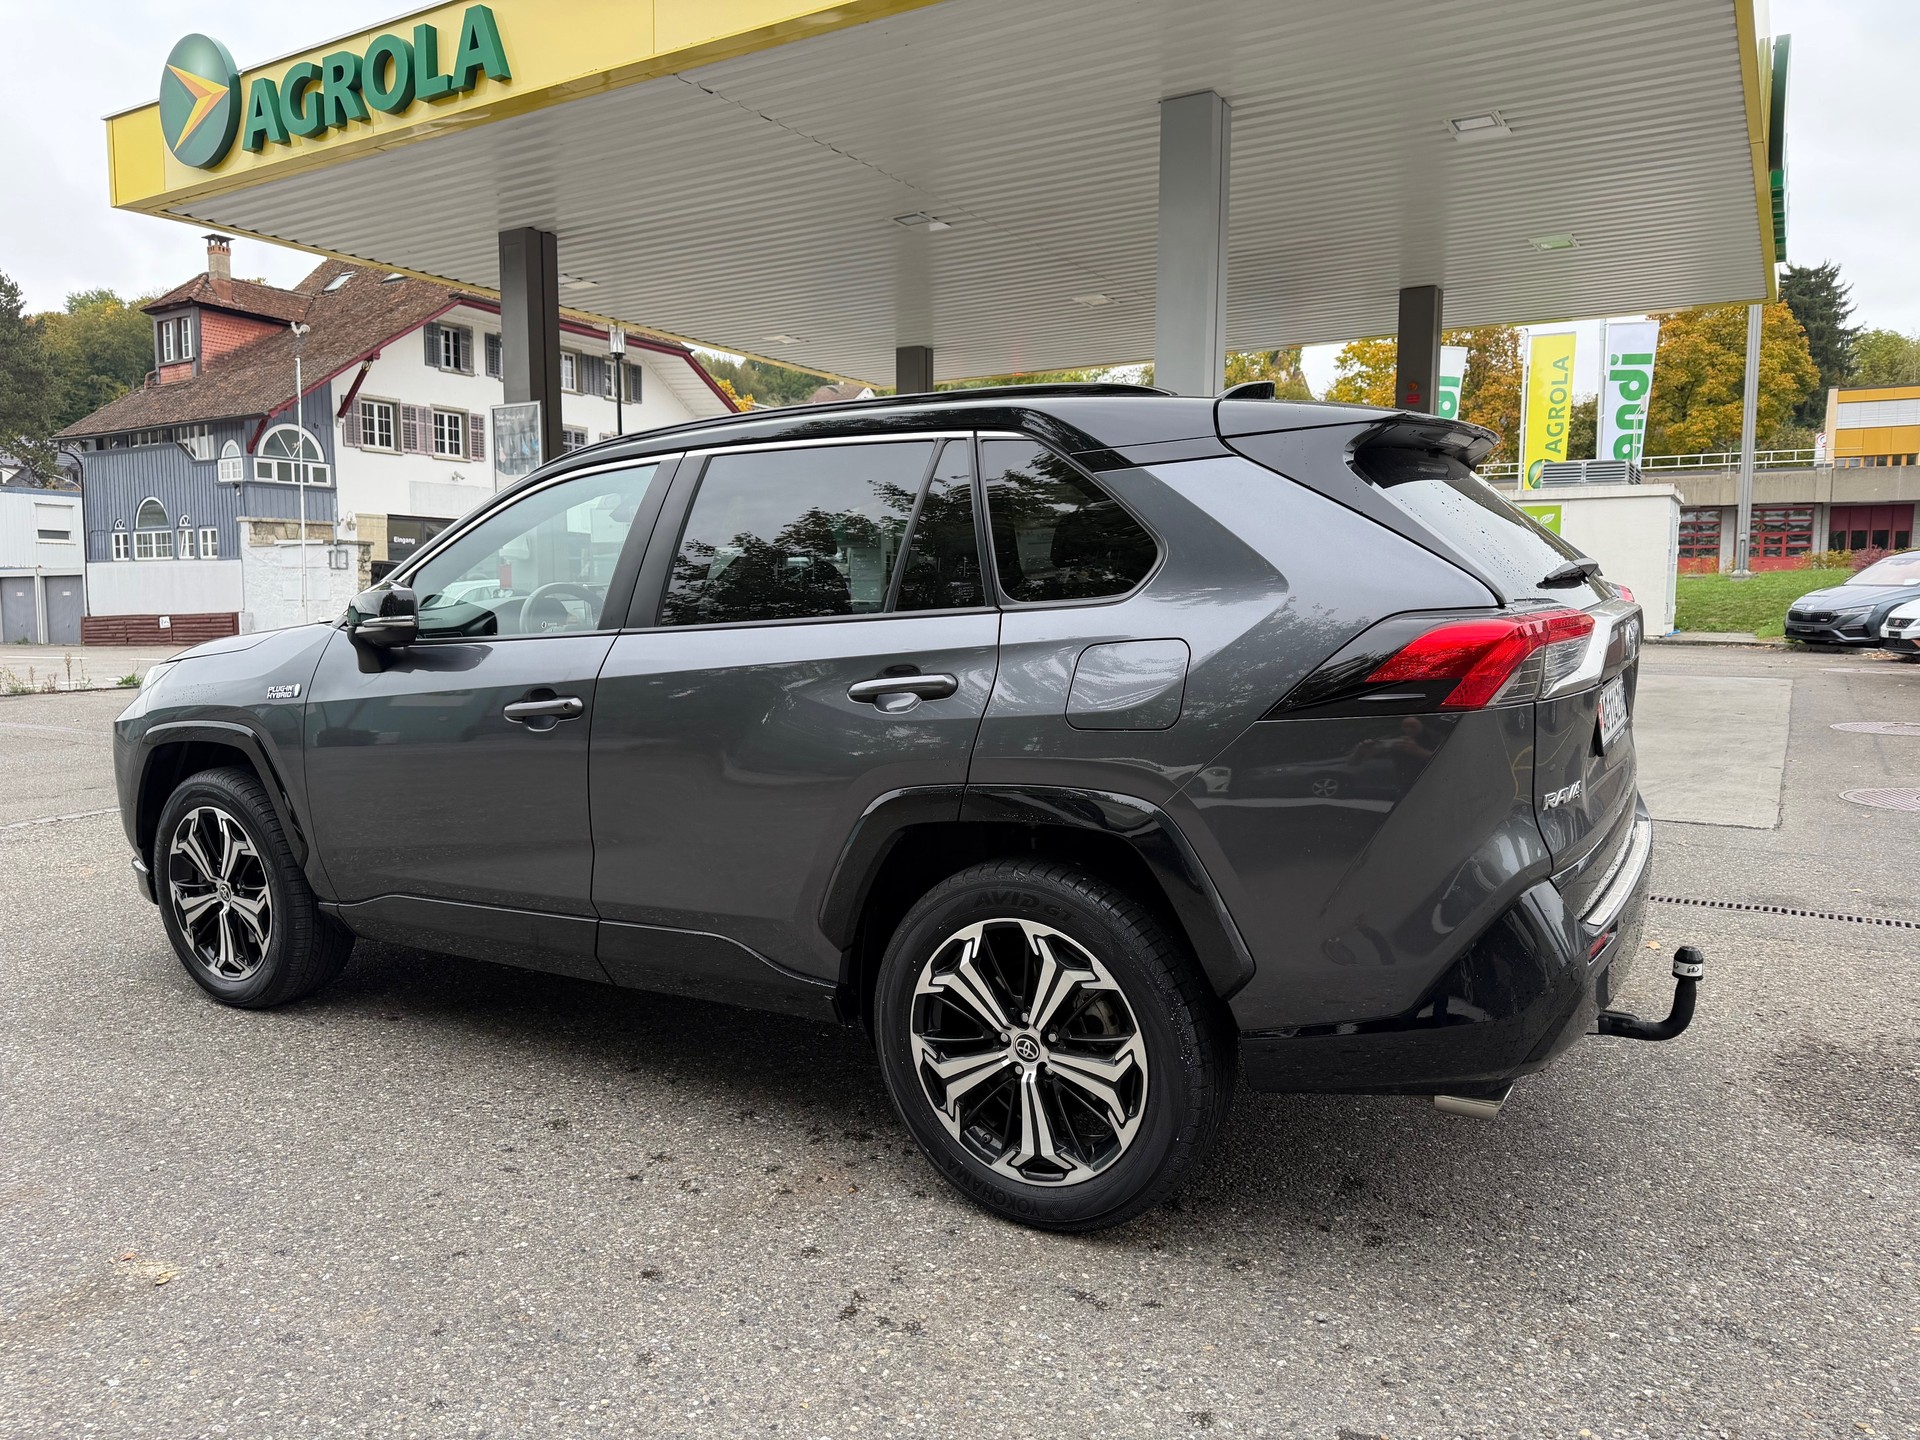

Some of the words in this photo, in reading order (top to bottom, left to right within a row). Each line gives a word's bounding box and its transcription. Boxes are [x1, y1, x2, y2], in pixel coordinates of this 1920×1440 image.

[242, 4, 512, 153] AGROLA
[1545, 355, 1569, 454] AGROLA
[1609, 353, 1653, 461] andi
[393, 536, 416, 545] Eingang
[266, 691, 293, 699] HYBRID
[1542, 780, 1582, 811] RAV4
[973, 890, 1040, 909] AVID
[1043, 904, 1078, 922] GT
[946, 1159, 1040, 1218] YOKOHAMA
